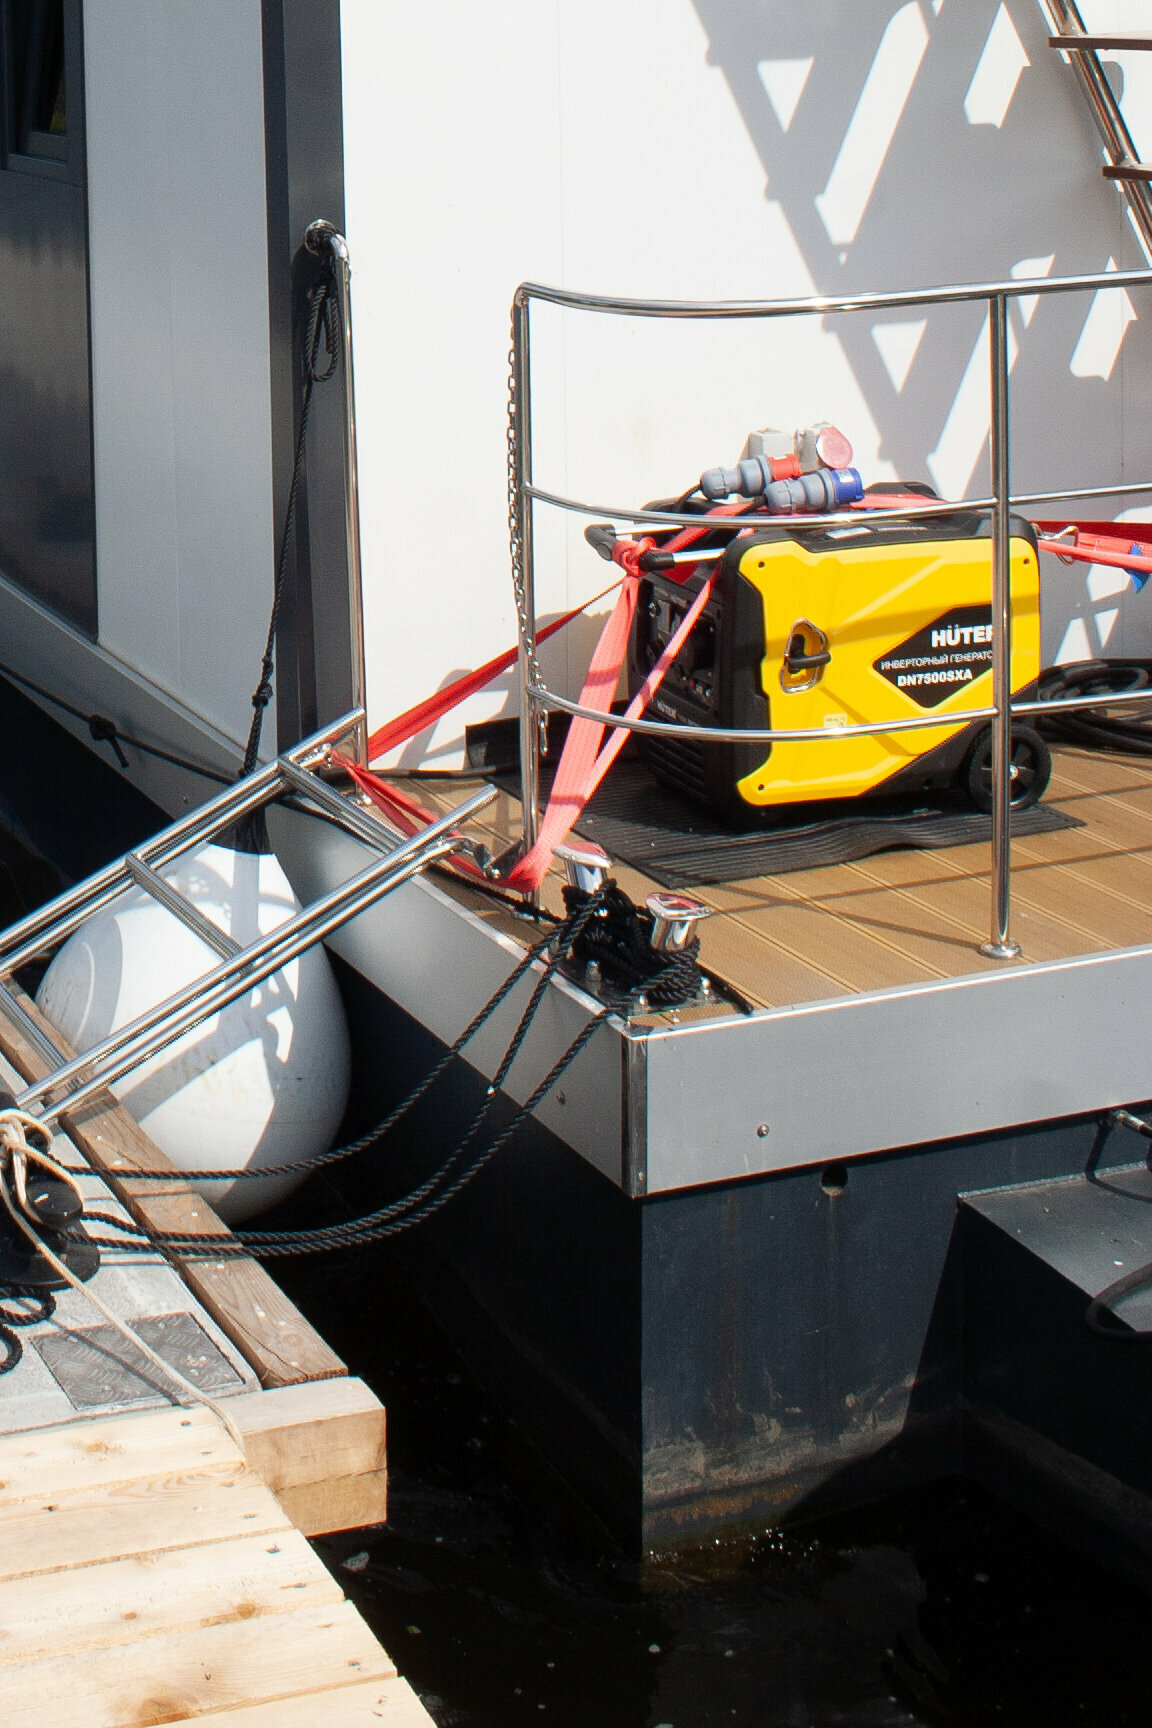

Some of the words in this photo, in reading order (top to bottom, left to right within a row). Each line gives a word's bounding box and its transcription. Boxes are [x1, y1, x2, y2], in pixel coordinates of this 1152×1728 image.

[881, 654, 948, 670] ИНВЕРТОРНЫЙ
[950, 650, 993, 663] ГЕНЕРАТО
[897, 668, 973, 687] DN7500SXA
